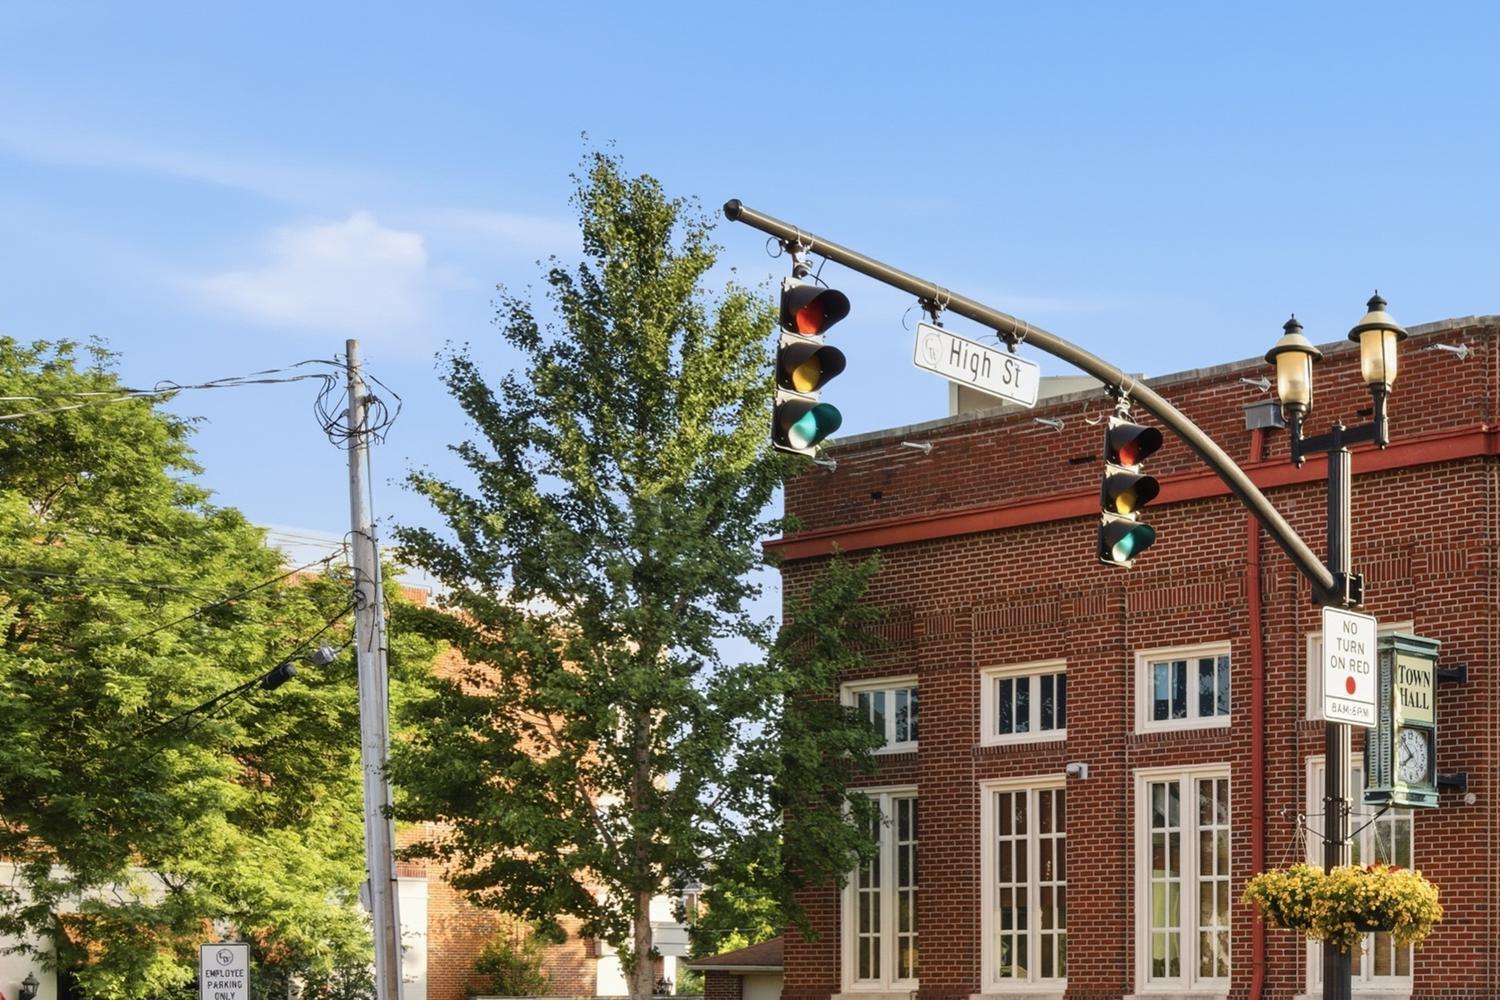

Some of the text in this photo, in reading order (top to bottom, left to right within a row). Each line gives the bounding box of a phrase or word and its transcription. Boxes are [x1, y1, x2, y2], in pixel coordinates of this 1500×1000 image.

[949, 338, 991, 382] High
[1002, 358, 1021, 388] St
[1343, 620, 1358, 635] NO
[1336, 637, 1365, 656] TURN
[1330, 655, 1370, 675] ON RED
[1399, 664, 1431, 688] TOWN
[1399, 687, 1430, 710] HALL
[205, 969, 244, 978] EMPLOYEE
[207, 981, 242, 989] PARKING
[214, 992, 235, 1000] ONLY
